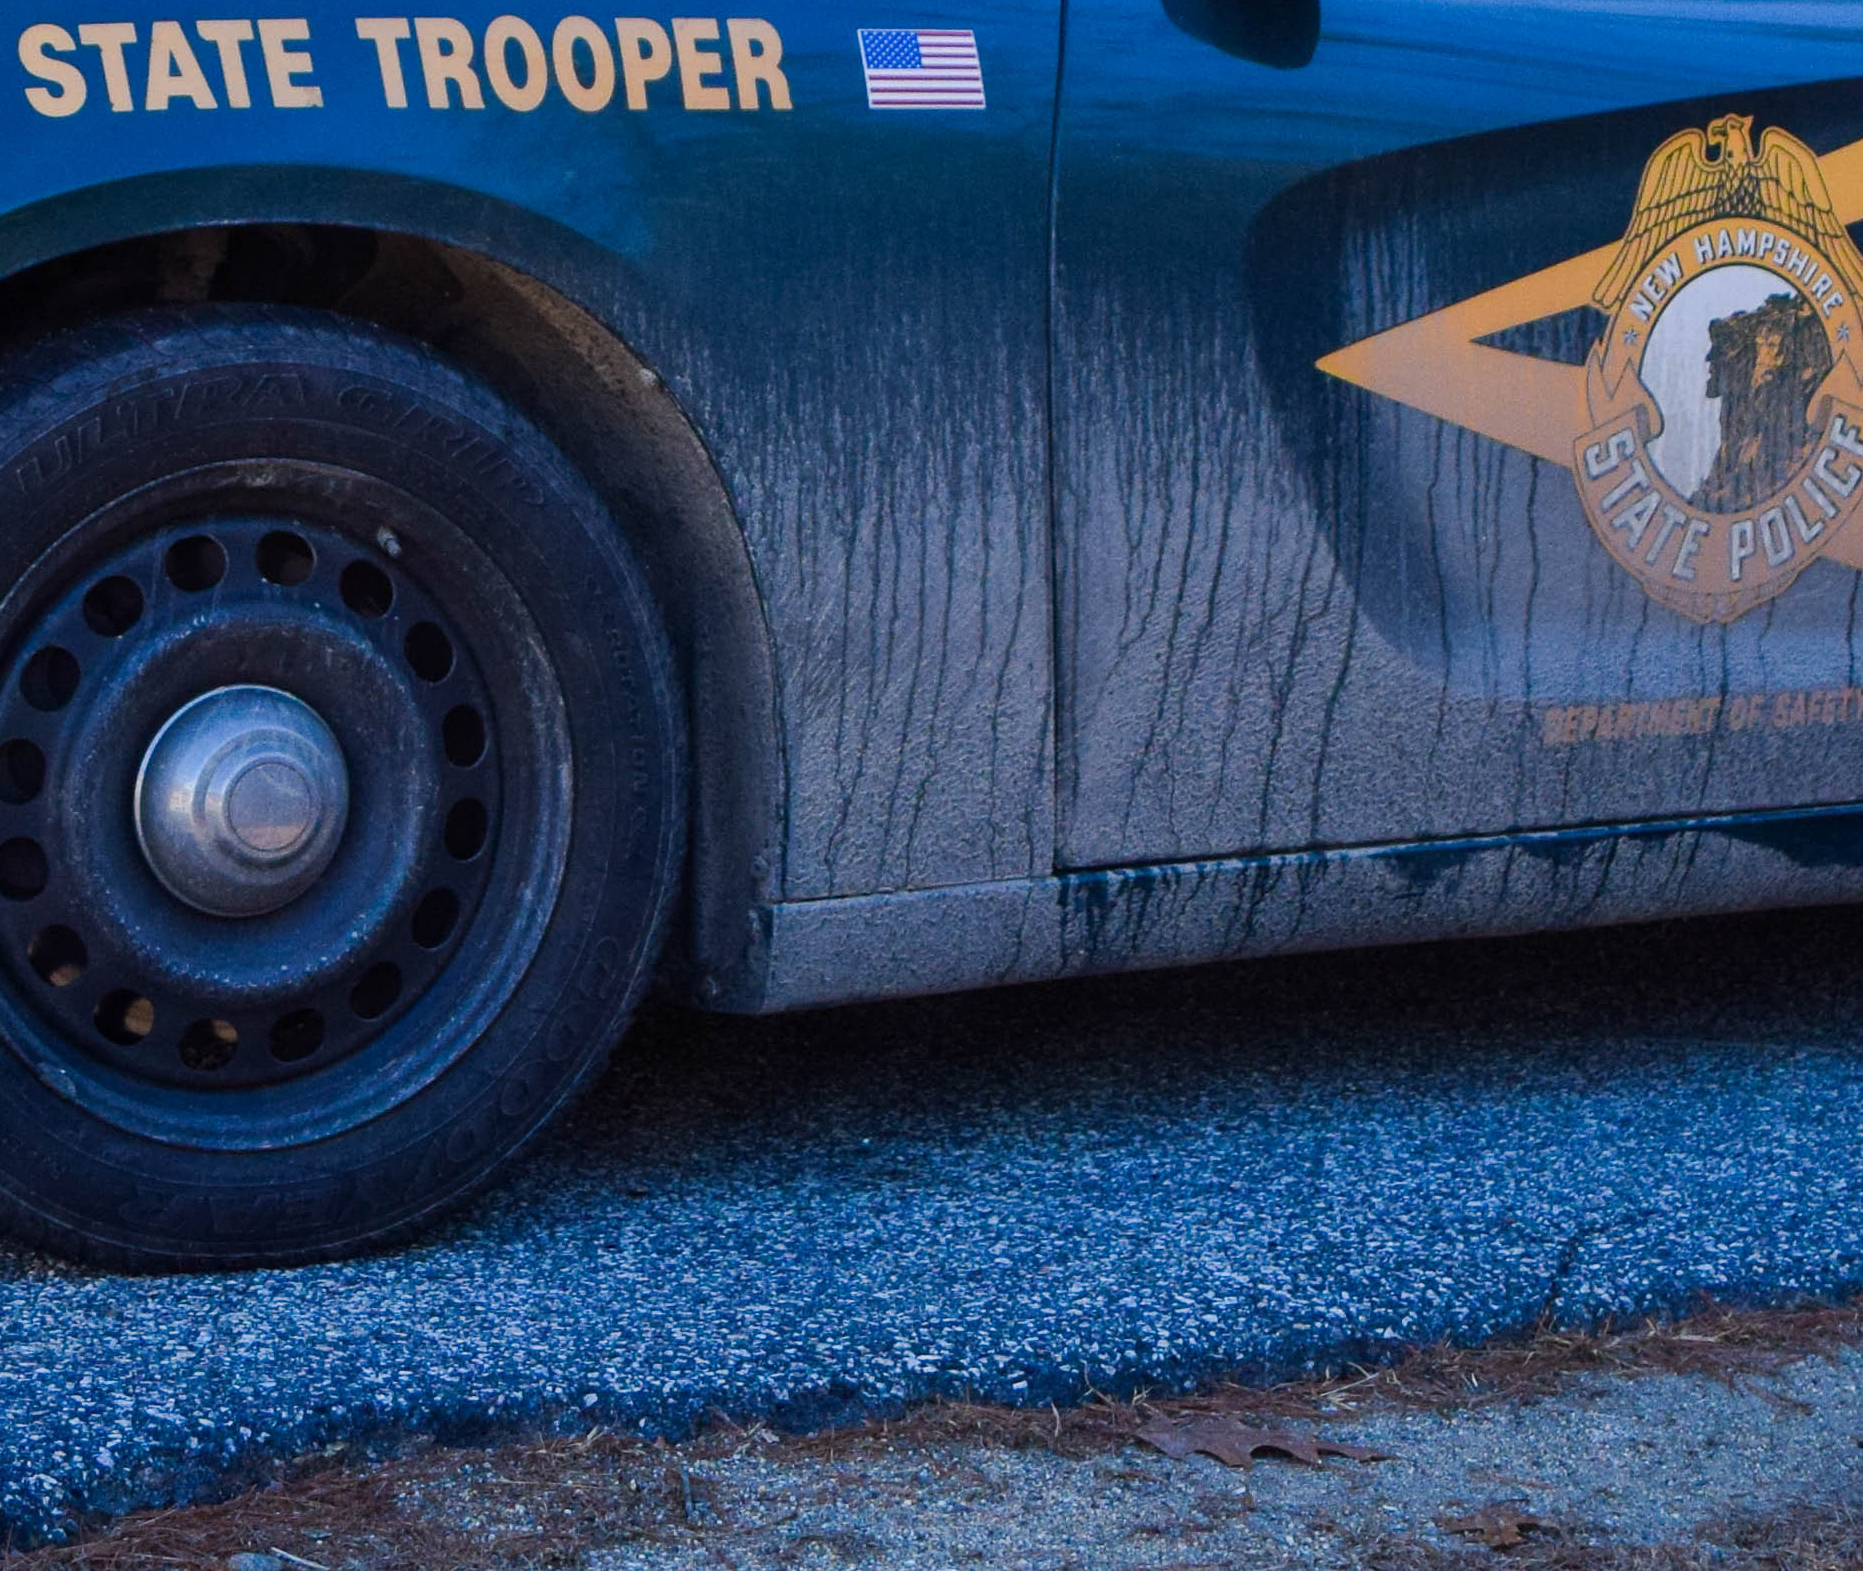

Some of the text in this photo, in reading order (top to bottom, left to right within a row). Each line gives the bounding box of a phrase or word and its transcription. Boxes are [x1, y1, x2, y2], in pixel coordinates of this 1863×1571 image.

[18, 14, 794, 118] STATE TROOPER
[1628, 227, 1845, 321] NEW HAMPSHIRE
[1584, 426, 1711, 580] STATE
[1728, 691, 1766, 731] OF
